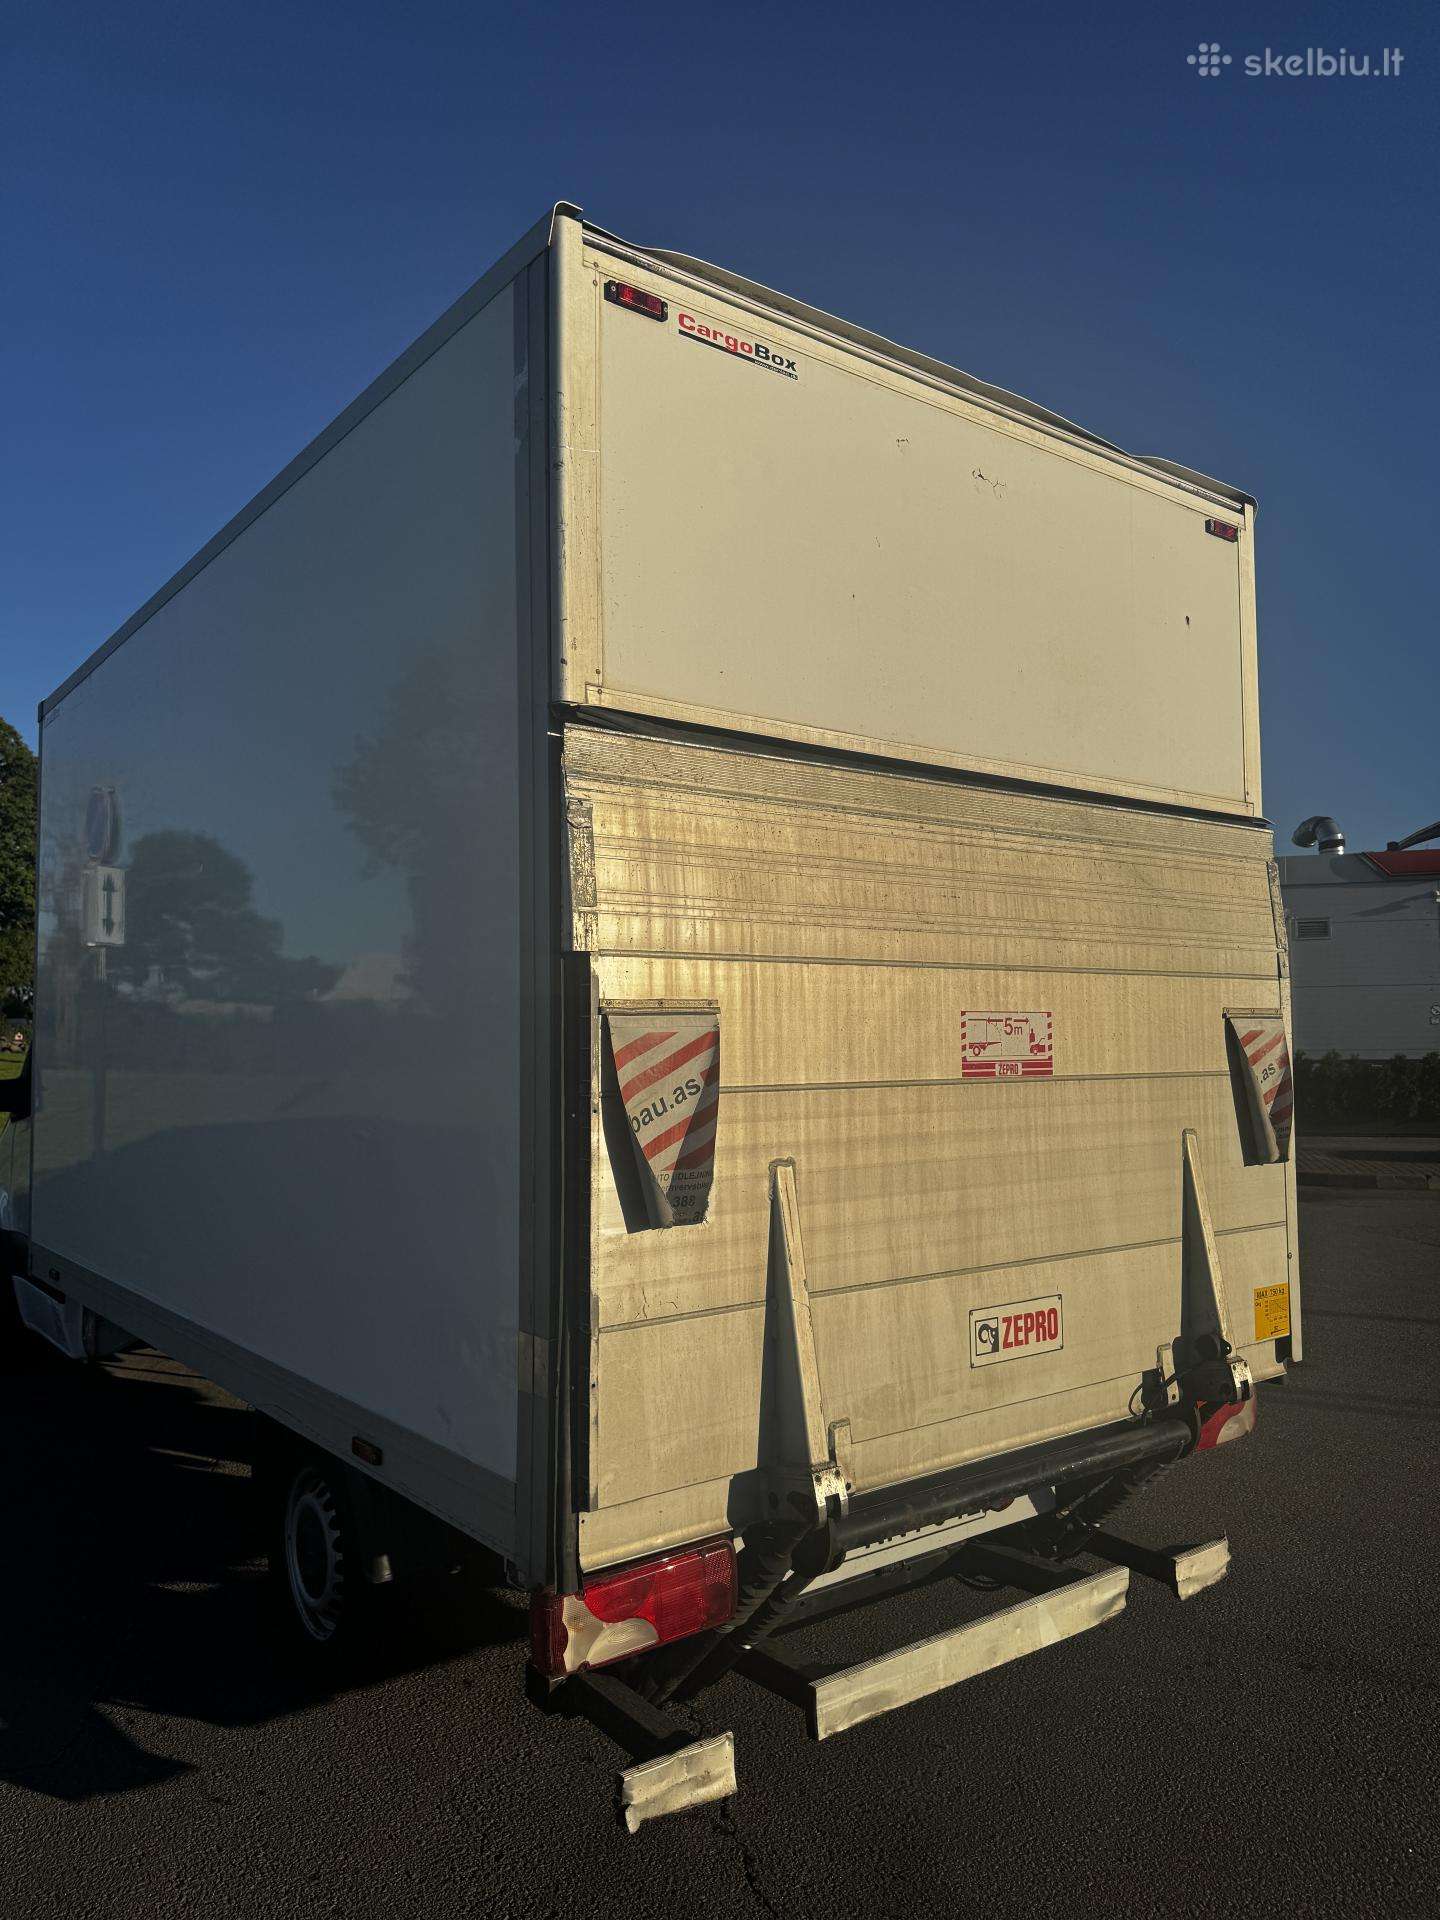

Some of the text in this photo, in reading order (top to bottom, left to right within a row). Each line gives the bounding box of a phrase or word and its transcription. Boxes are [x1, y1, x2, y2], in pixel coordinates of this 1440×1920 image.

[678, 312, 798, 373] CargoBox
[998, 1063, 1019, 1075] ZEPRO
[1001, 1307, 1059, 1349] ZEPRO
